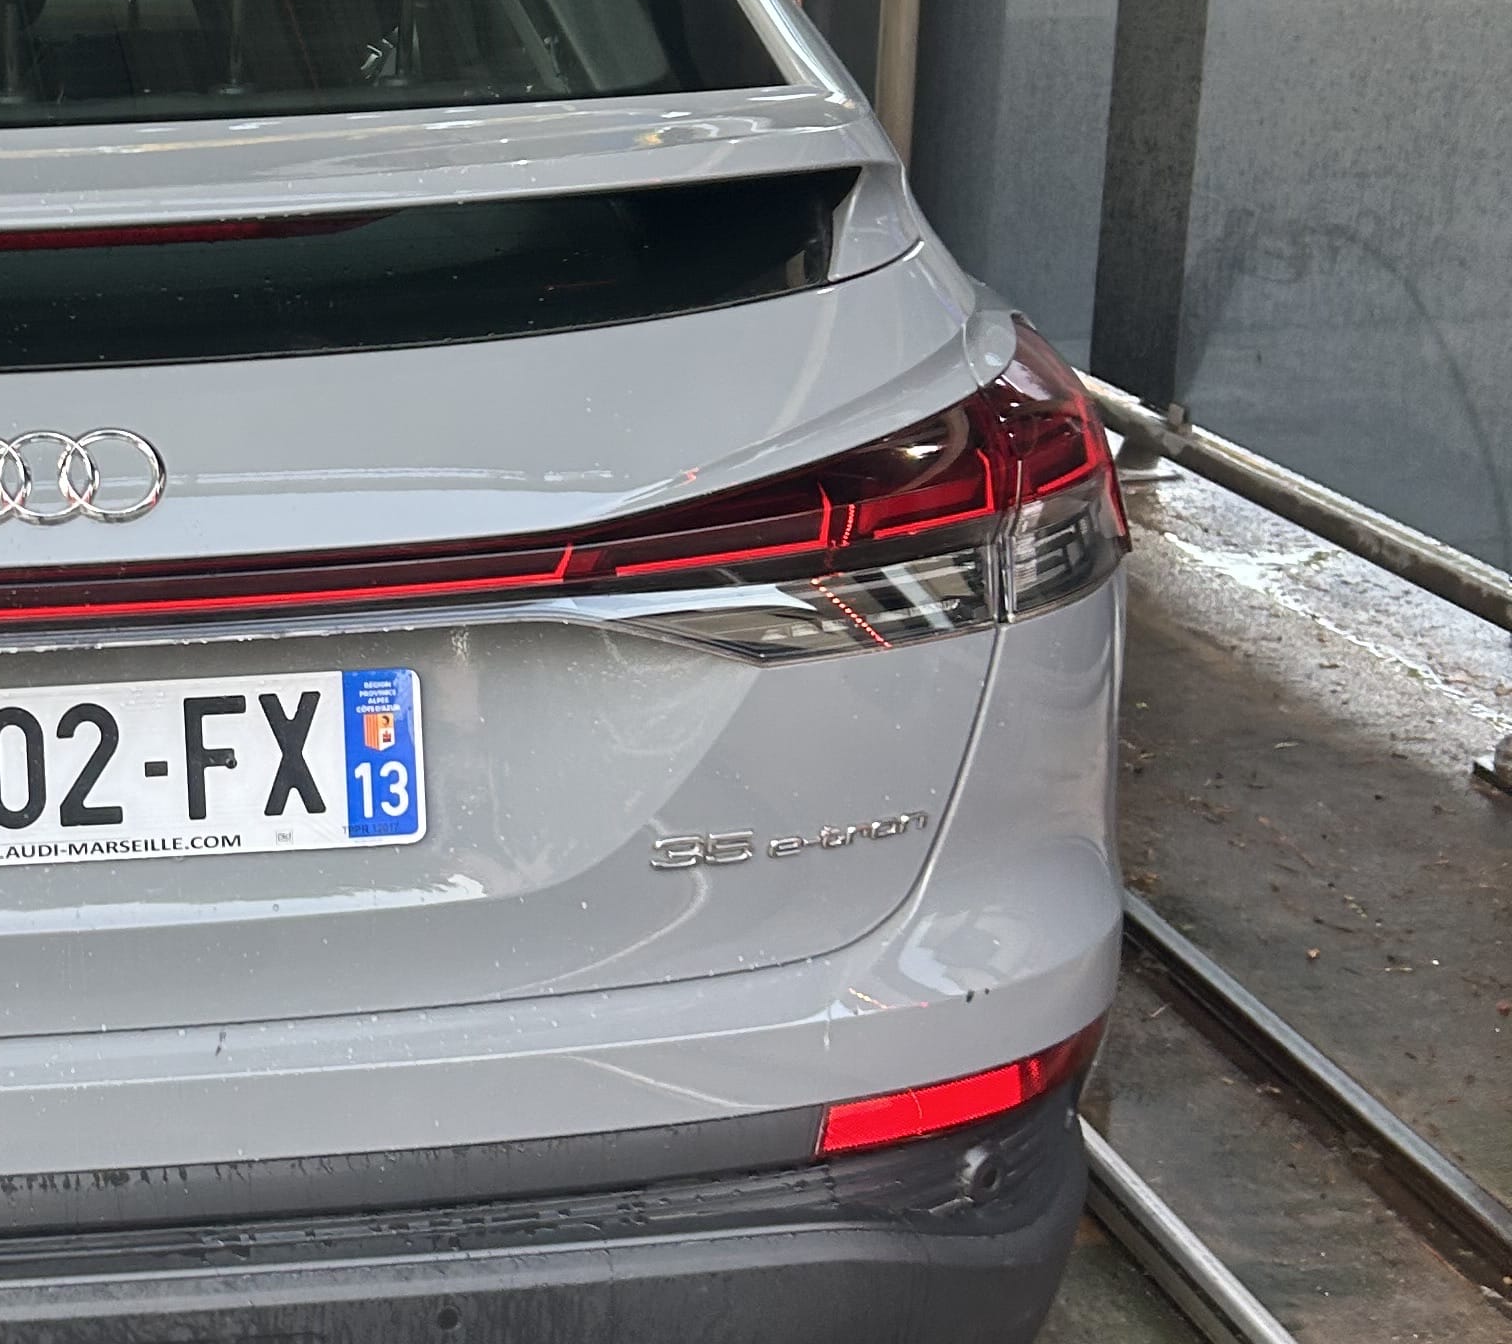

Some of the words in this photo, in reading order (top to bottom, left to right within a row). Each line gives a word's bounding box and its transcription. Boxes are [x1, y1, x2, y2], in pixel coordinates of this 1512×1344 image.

[354, 760, 409, 819] 13
[650, 828, 754, 871] 35
[767, 810, 929, 858] e-tron
